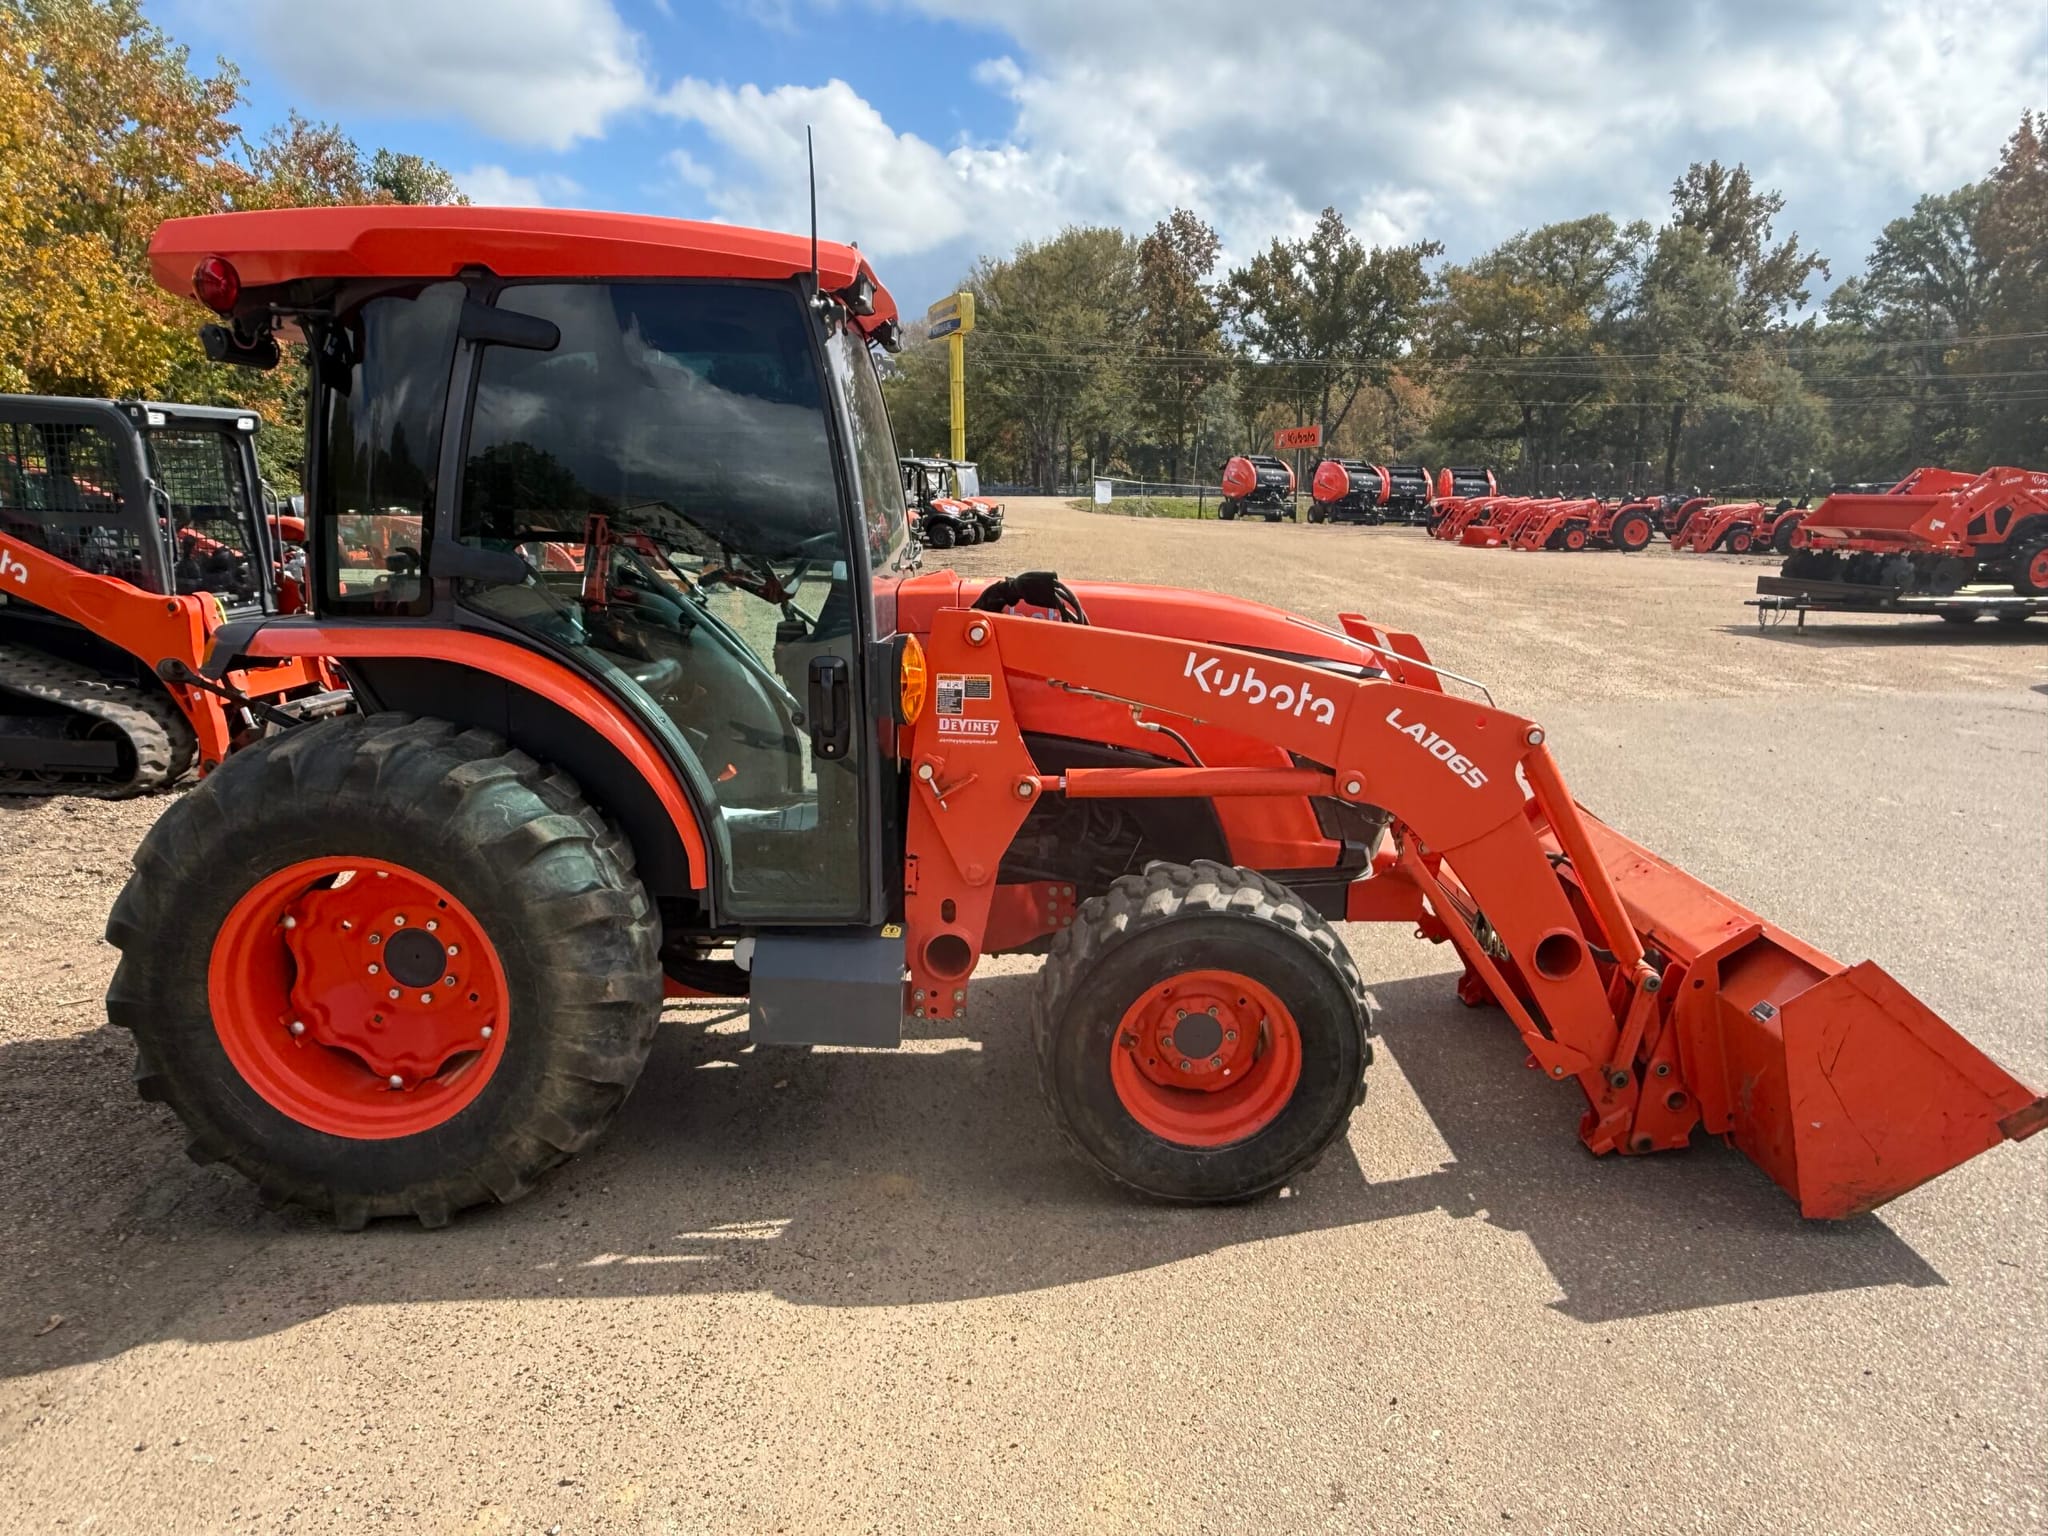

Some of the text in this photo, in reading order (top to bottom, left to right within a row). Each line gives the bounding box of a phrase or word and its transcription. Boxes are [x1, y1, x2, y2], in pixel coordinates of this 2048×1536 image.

[1287, 432, 1316, 443] Kubota
[1183, 651, 1335, 725] Kubota
[1385, 707, 1488, 789] LA1065
